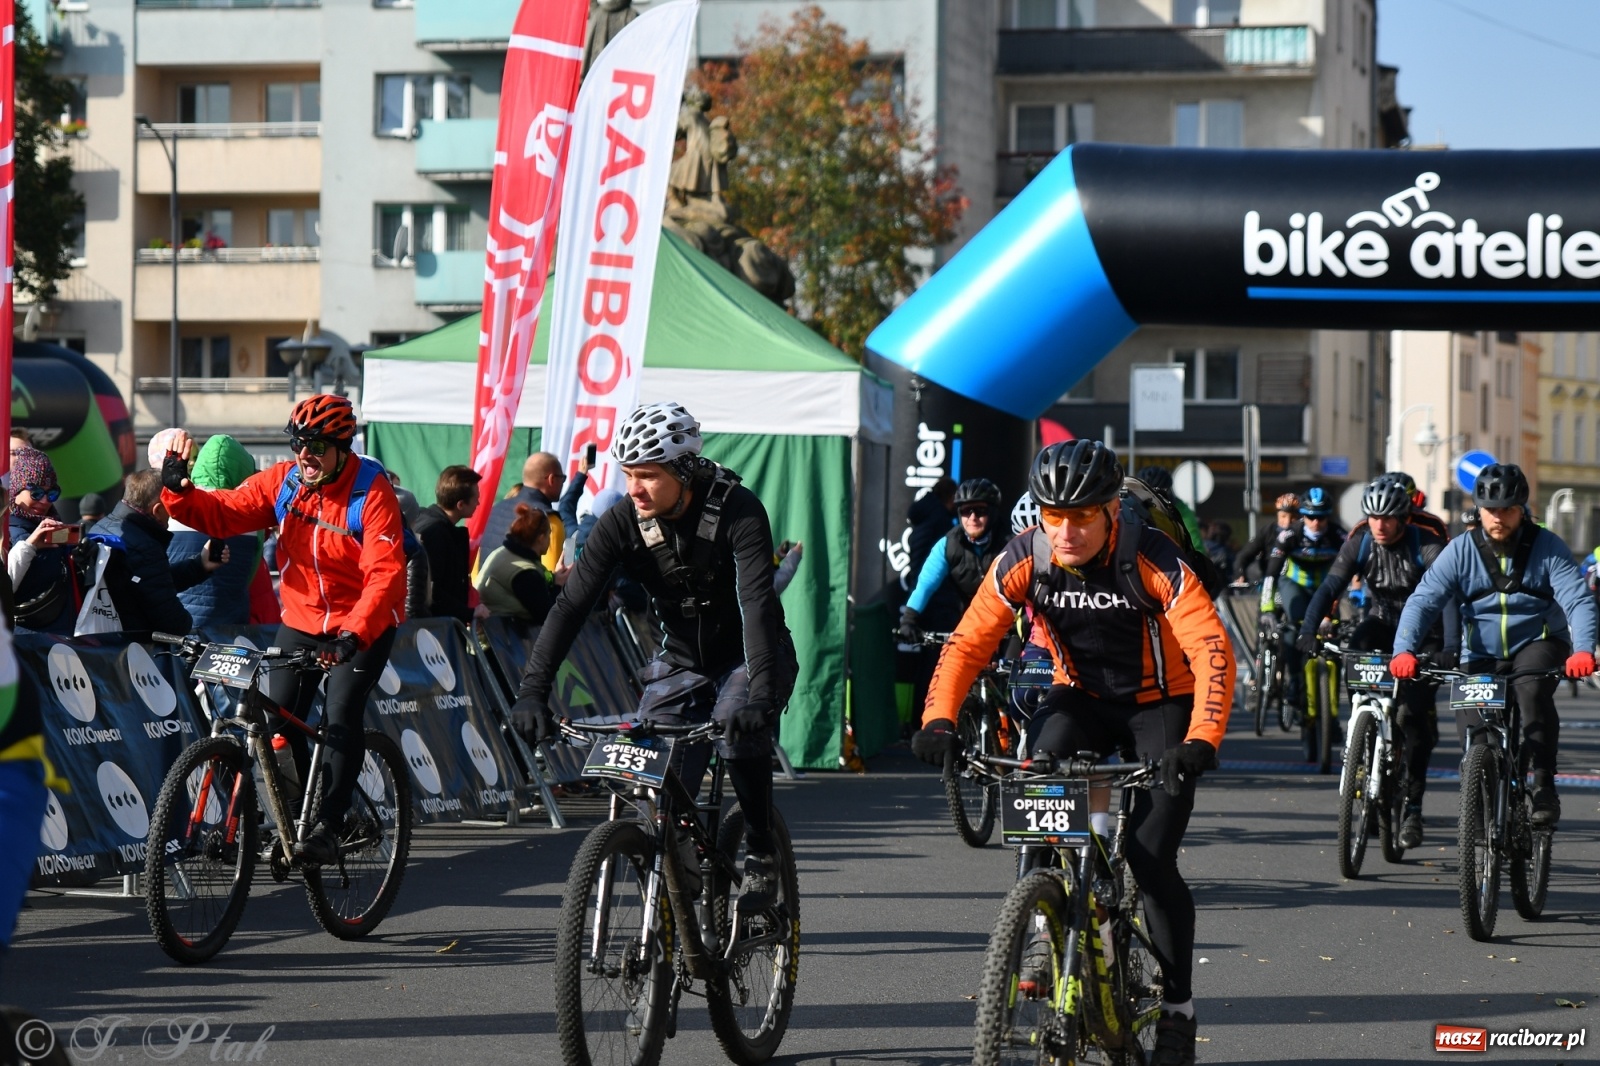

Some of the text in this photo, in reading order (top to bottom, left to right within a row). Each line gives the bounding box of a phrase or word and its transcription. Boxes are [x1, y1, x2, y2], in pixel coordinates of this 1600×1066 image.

[1244, 210, 1390, 278] bike
[1044, 591, 1138, 610] HITACH
[209, 653, 251, 665] OPIEKUN
[1353, 663, 1388, 671] OPIEKUN
[208, 660, 241, 677] 288
[1022, 667, 1054, 675] PIEKUN
[1360, 670, 1384, 683] 107
[1202, 634, 1228, 724] HITACHI
[1459, 683, 1499, 692] OPIEKUN
[1464, 689, 1494, 701] 220
[375, 698, 419, 715] KOKOwear
[63, 726, 123, 746] KOKOwear
[602, 744, 659, 760] OPIEKUN
[604, 752, 646, 772] 153
[1013, 799, 1076, 811] OPIEKUN
[1025, 811, 1070, 832] 148
[37, 854, 97, 876] KOKOwear
